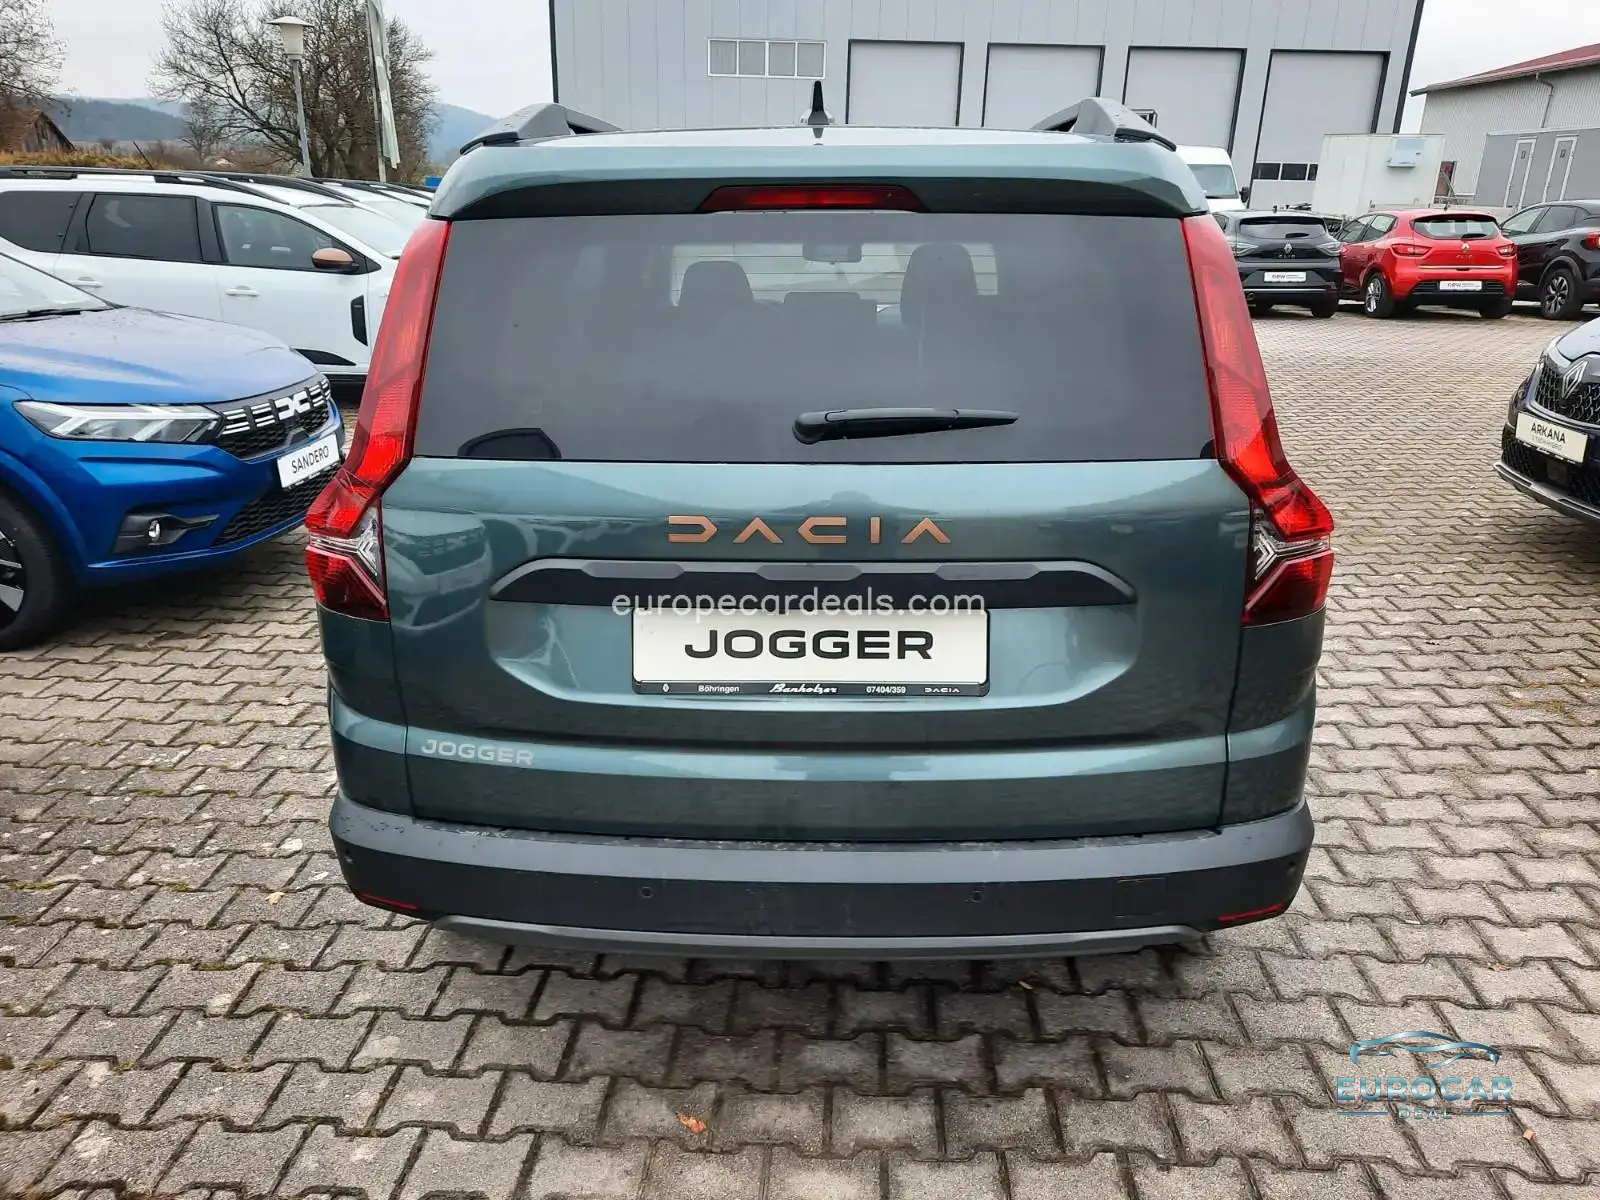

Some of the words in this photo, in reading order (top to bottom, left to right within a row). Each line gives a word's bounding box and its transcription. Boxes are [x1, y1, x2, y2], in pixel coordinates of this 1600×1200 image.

[1531, 422, 1566, 443] ARKANA
[292, 445, 329, 474] SANDERO
[667, 515, 951, 544] DACIA
[684, 629, 934, 660] JOGGER
[698, 684, 740, 694] Böhringen
[865, 685, 906, 694] 07404/359
[421, 739, 534, 765] JOGGER
